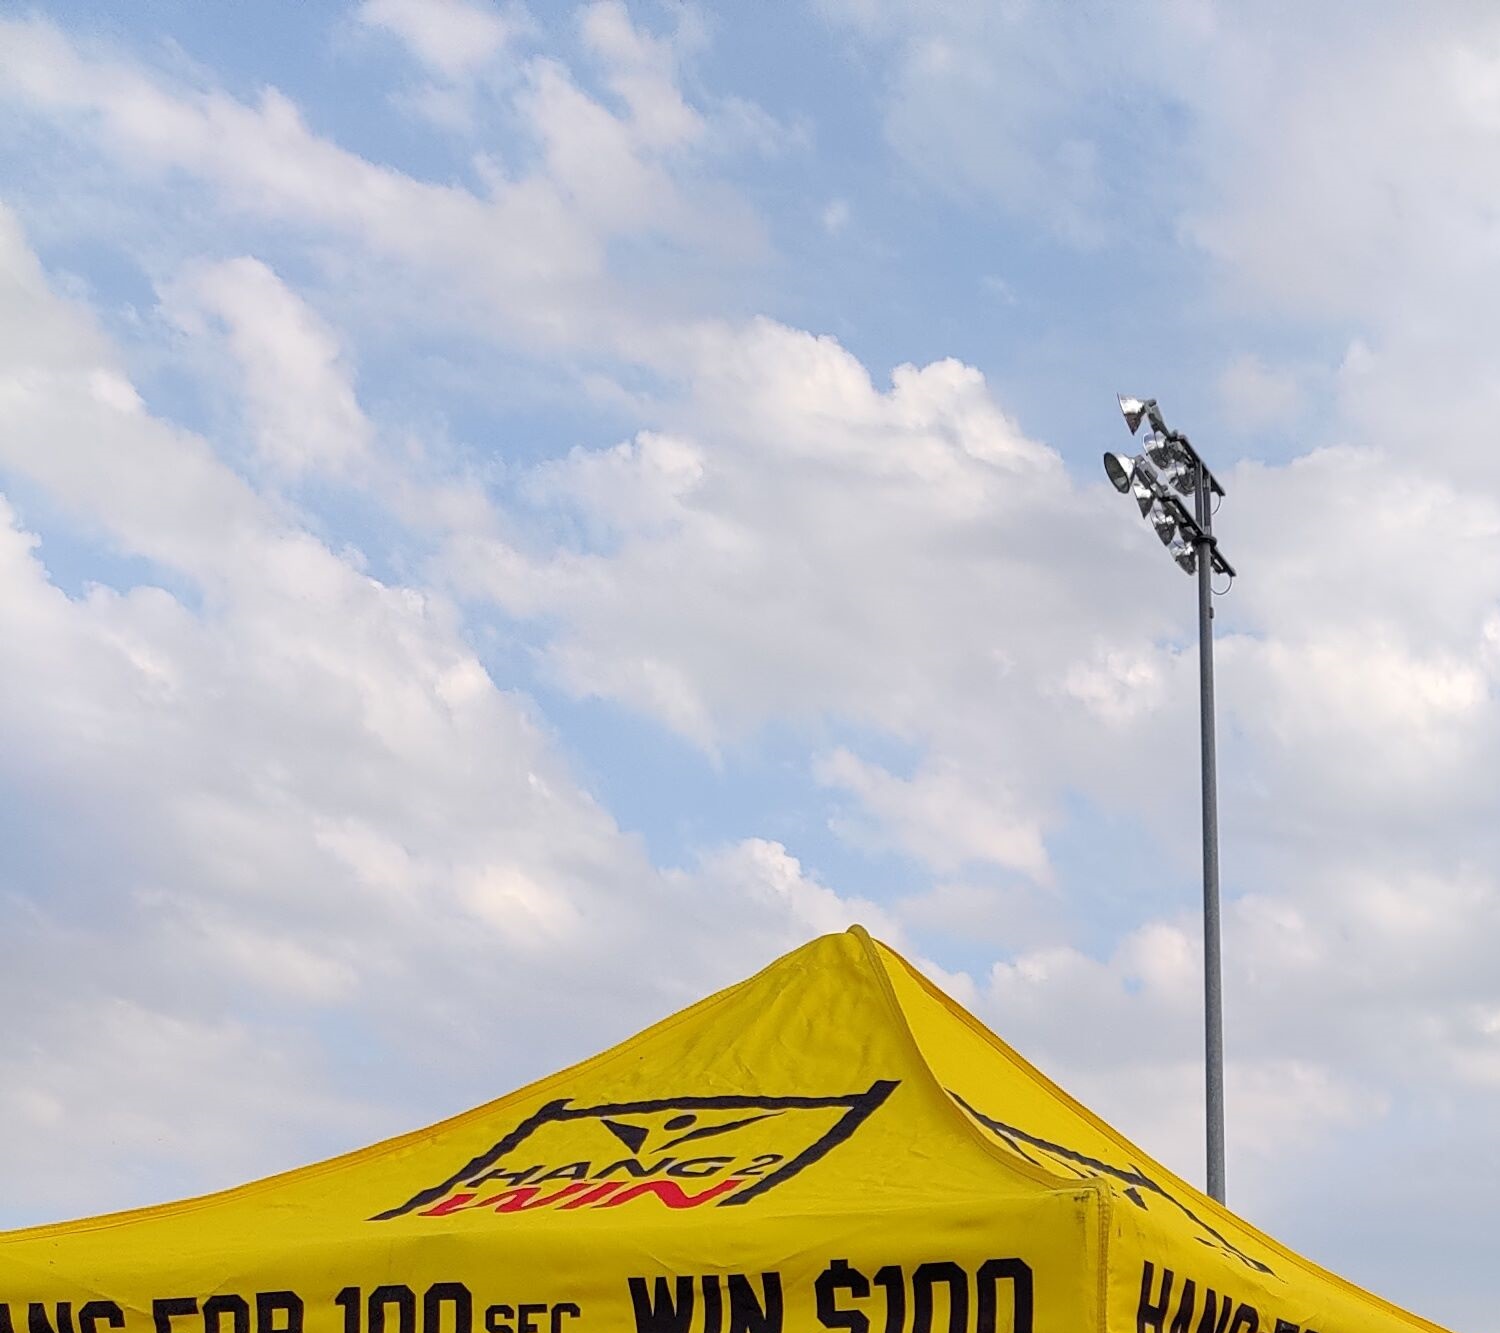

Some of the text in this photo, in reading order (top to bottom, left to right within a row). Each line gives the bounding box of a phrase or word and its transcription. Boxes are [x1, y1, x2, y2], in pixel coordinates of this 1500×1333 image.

[466, 1154, 784, 1188] HANG 2
[417, 1179, 746, 1216] WIN
